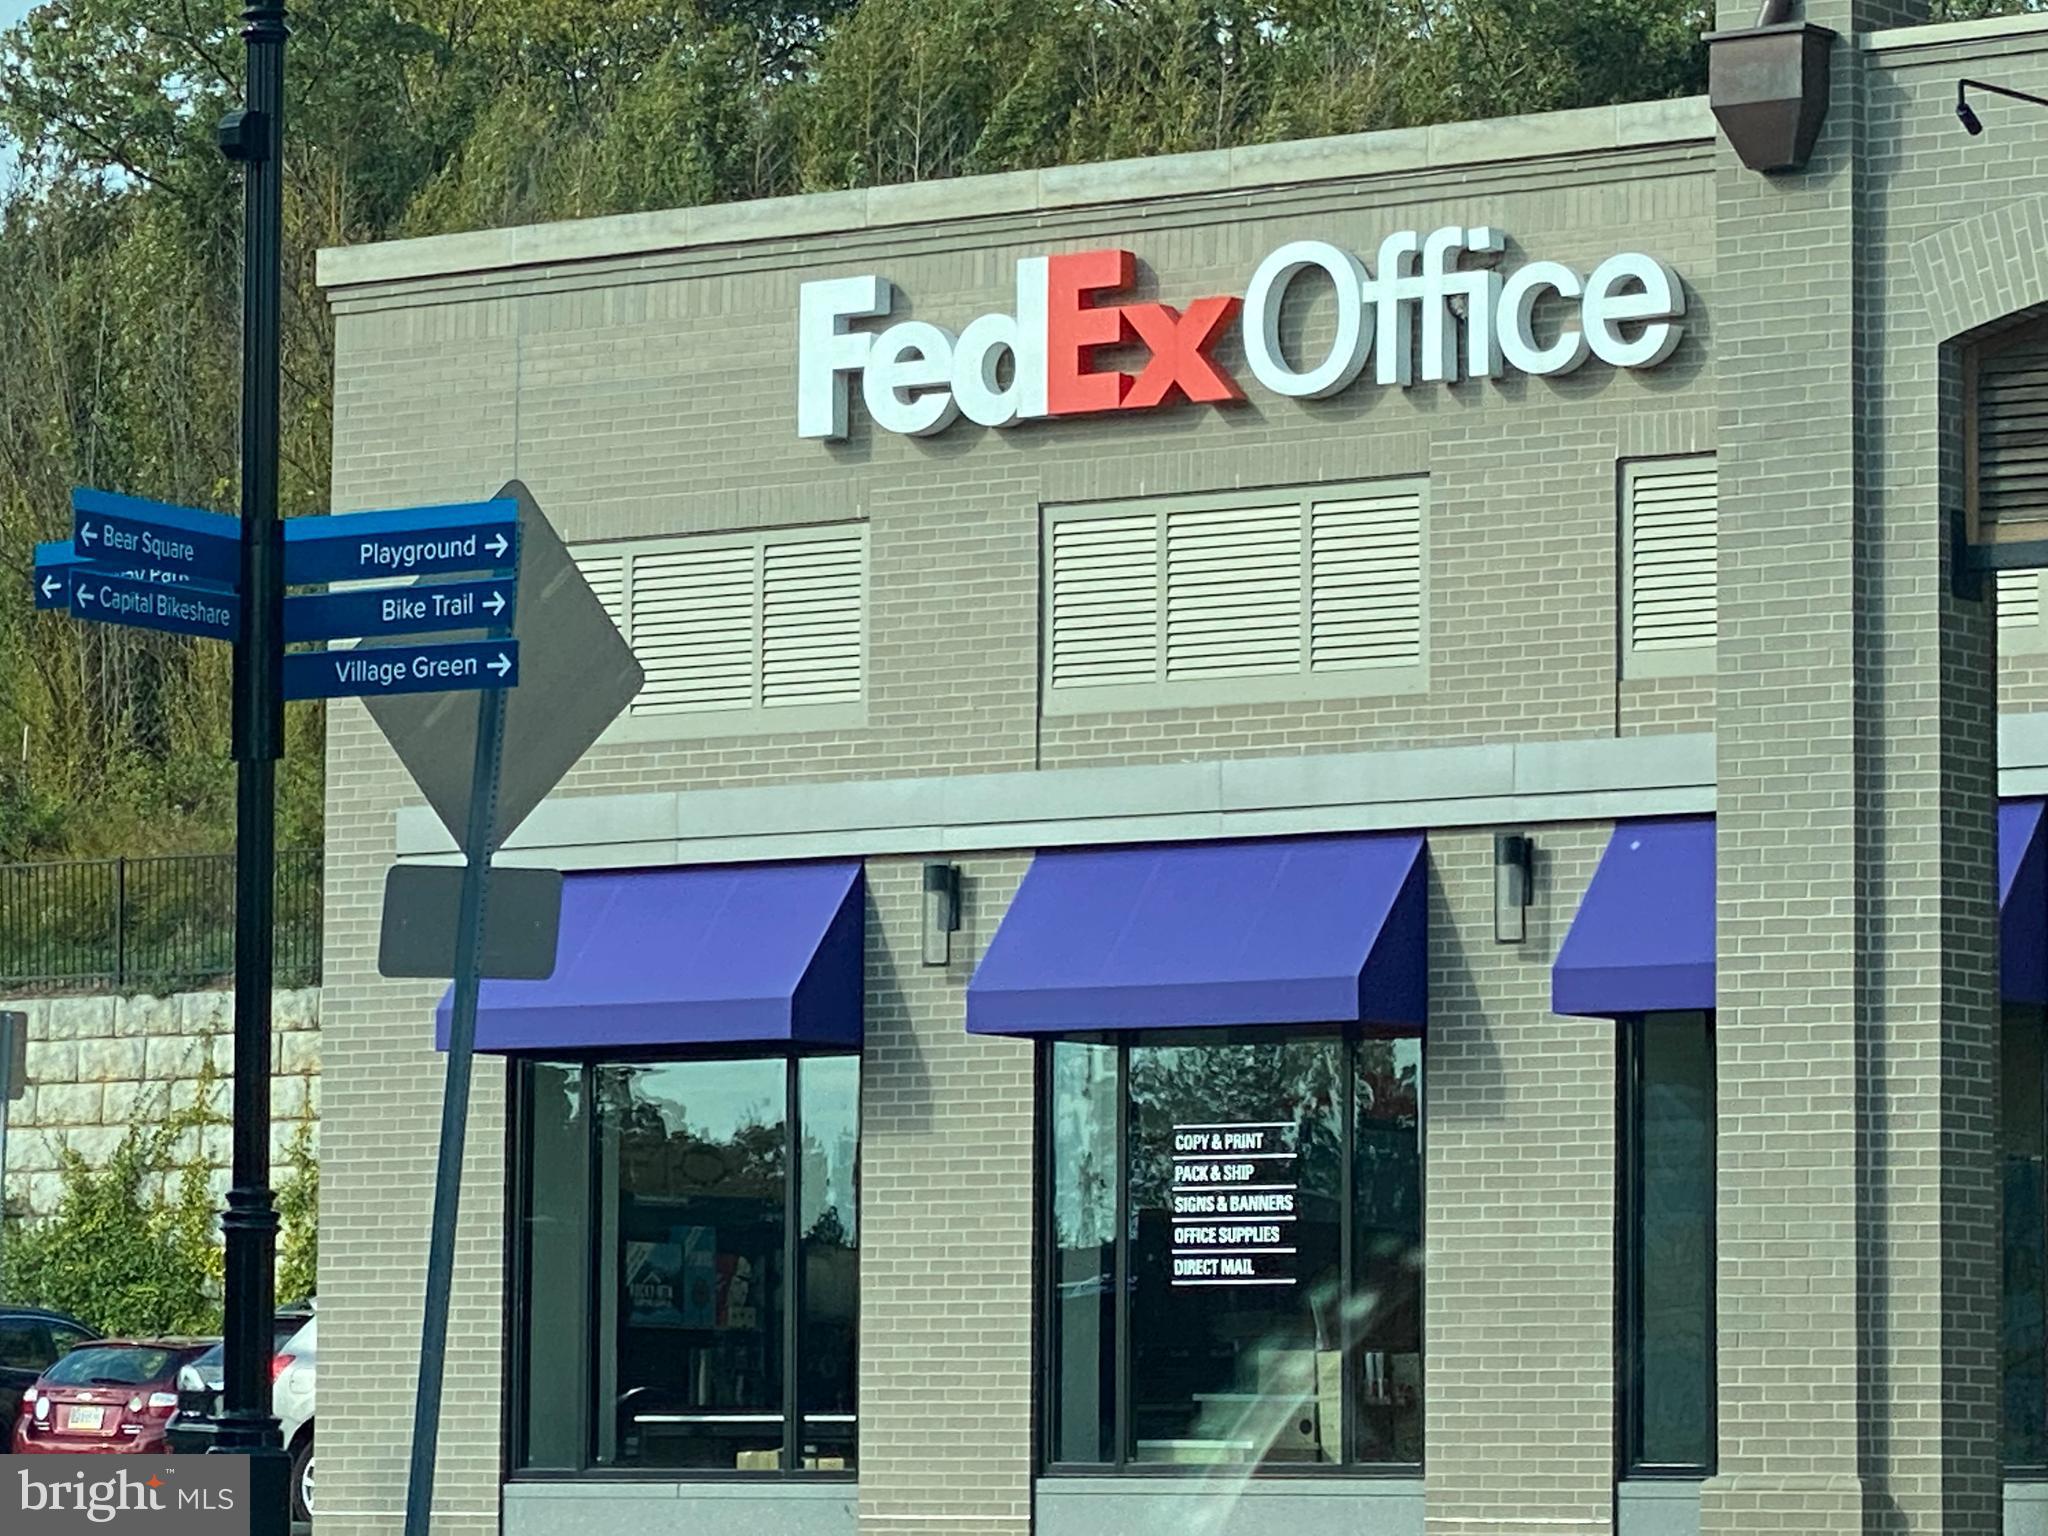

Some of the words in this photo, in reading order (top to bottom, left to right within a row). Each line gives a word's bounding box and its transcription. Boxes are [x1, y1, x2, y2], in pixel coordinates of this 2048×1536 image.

[103, 524, 138, 551] Bear
[142, 531, 195, 561] Square
[360, 534, 477, 569] Playground
[99, 585, 154, 614] Capital
[156, 594, 230, 627] Bikeshare
[382, 598, 427, 622] Bike
[432, 593, 474, 617] Trail
[335, 660, 407, 686] Village
[412, 656, 478, 679] Green
[1174, 1134, 1210, 1151] COPY
[1211, 1133, 1223, 1150] &
[1224, 1132, 1264, 1149] PRINT
[1174, 1165, 1209, 1182] PACK
[1210, 1165, 1222, 1181] &
[1223, 1164, 1255, 1181] SHIP
[1174, 1196, 1216, 1213] SIGNS
[1216, 1195, 1228, 1212] &
[1229, 1194, 1294, 1212] BANNERS
[1174, 1227, 1217, 1244] OFFICE
[1218, 1226, 1280, 1243] SUPPLIES
[1174, 1259, 1219, 1276] DIRECT
[1220, 1258, 1255, 1275] MAIL
